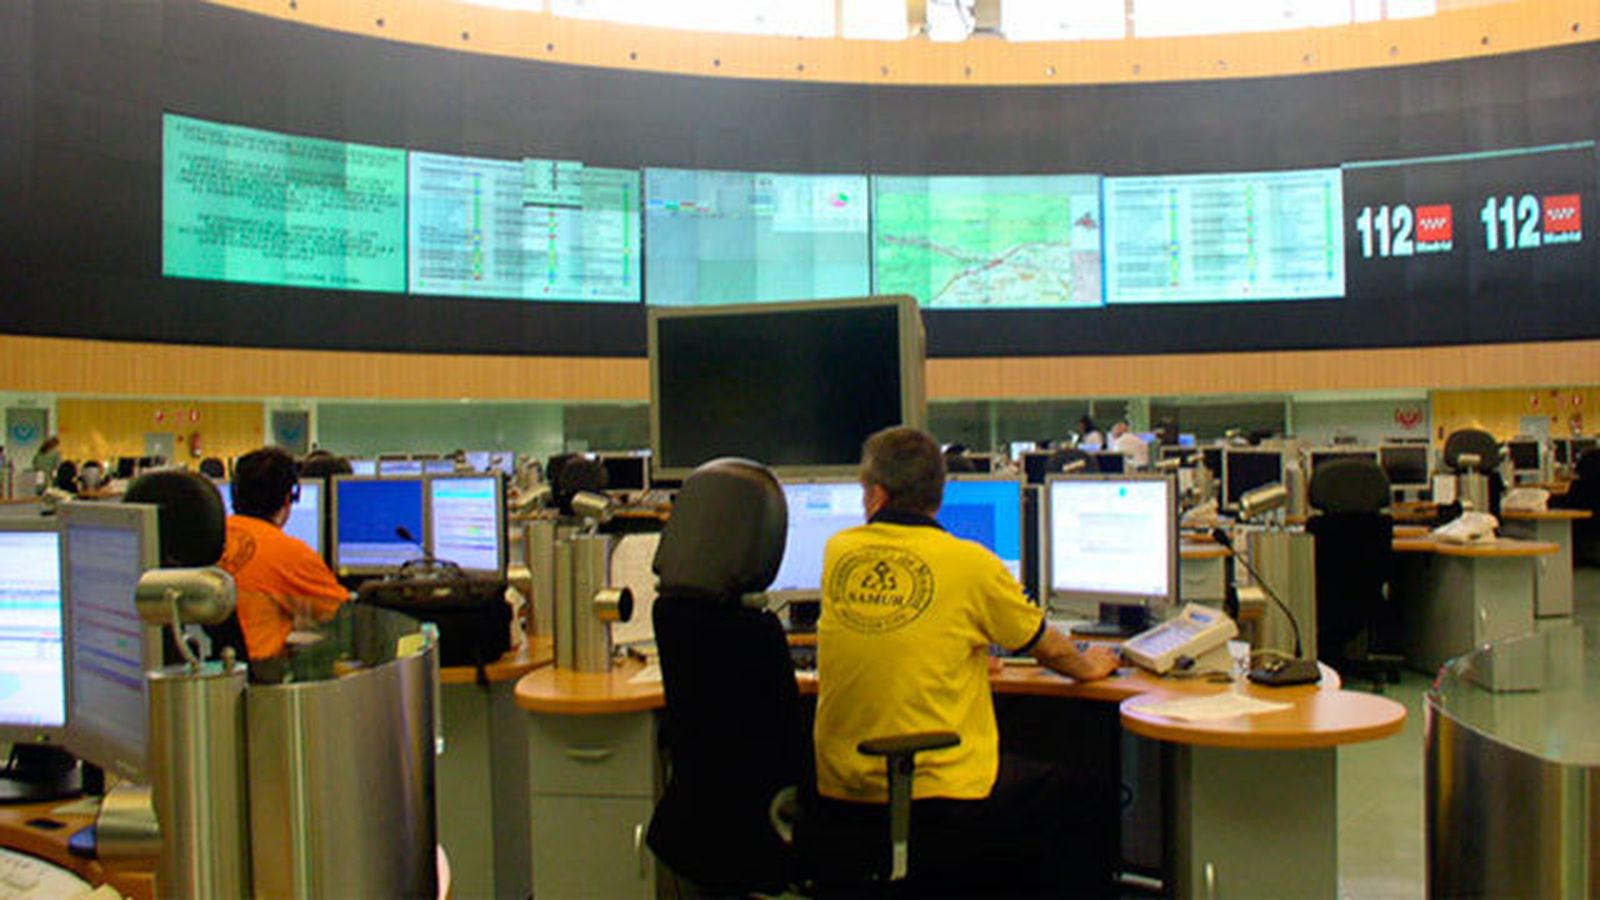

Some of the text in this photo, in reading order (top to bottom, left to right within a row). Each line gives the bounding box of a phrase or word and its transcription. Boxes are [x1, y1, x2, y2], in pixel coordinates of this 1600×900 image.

[1356, 204, 1414, 258] 112
[1480, 194, 1541, 251] 112
[848, 591, 904, 607] SAMUR
